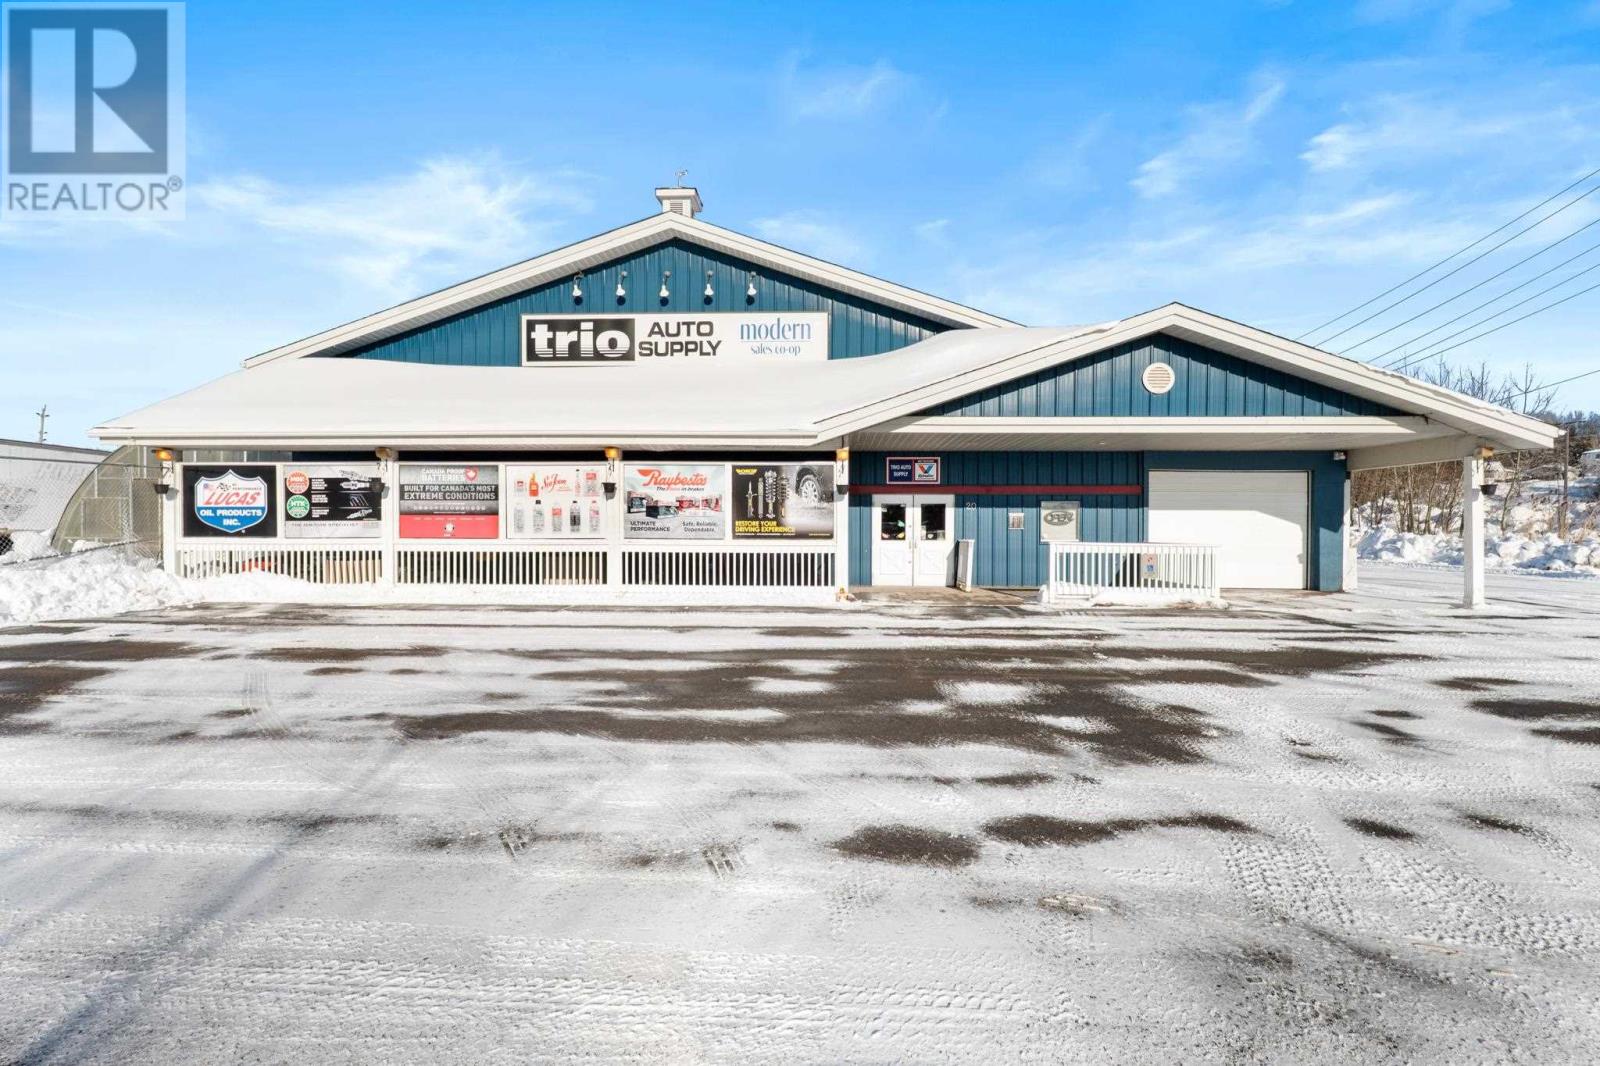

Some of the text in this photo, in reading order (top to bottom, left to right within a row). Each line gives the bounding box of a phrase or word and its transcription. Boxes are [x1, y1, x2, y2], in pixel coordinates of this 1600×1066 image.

[647, 320, 714, 338] AUTO
[740, 317, 812, 341] modern
[530, 321, 632, 358] trio
[638, 340, 722, 357] SUPPLY
[750, 342, 801, 356] sales co-op
[203, 491, 261, 506] LUCAS
[404, 492, 496, 500] EXTREME CONDITIONS
[200, 509, 262, 517] OIL PRODUCTS
[965, 502, 977, 510] 20
[223, 518, 241, 526] INC.
